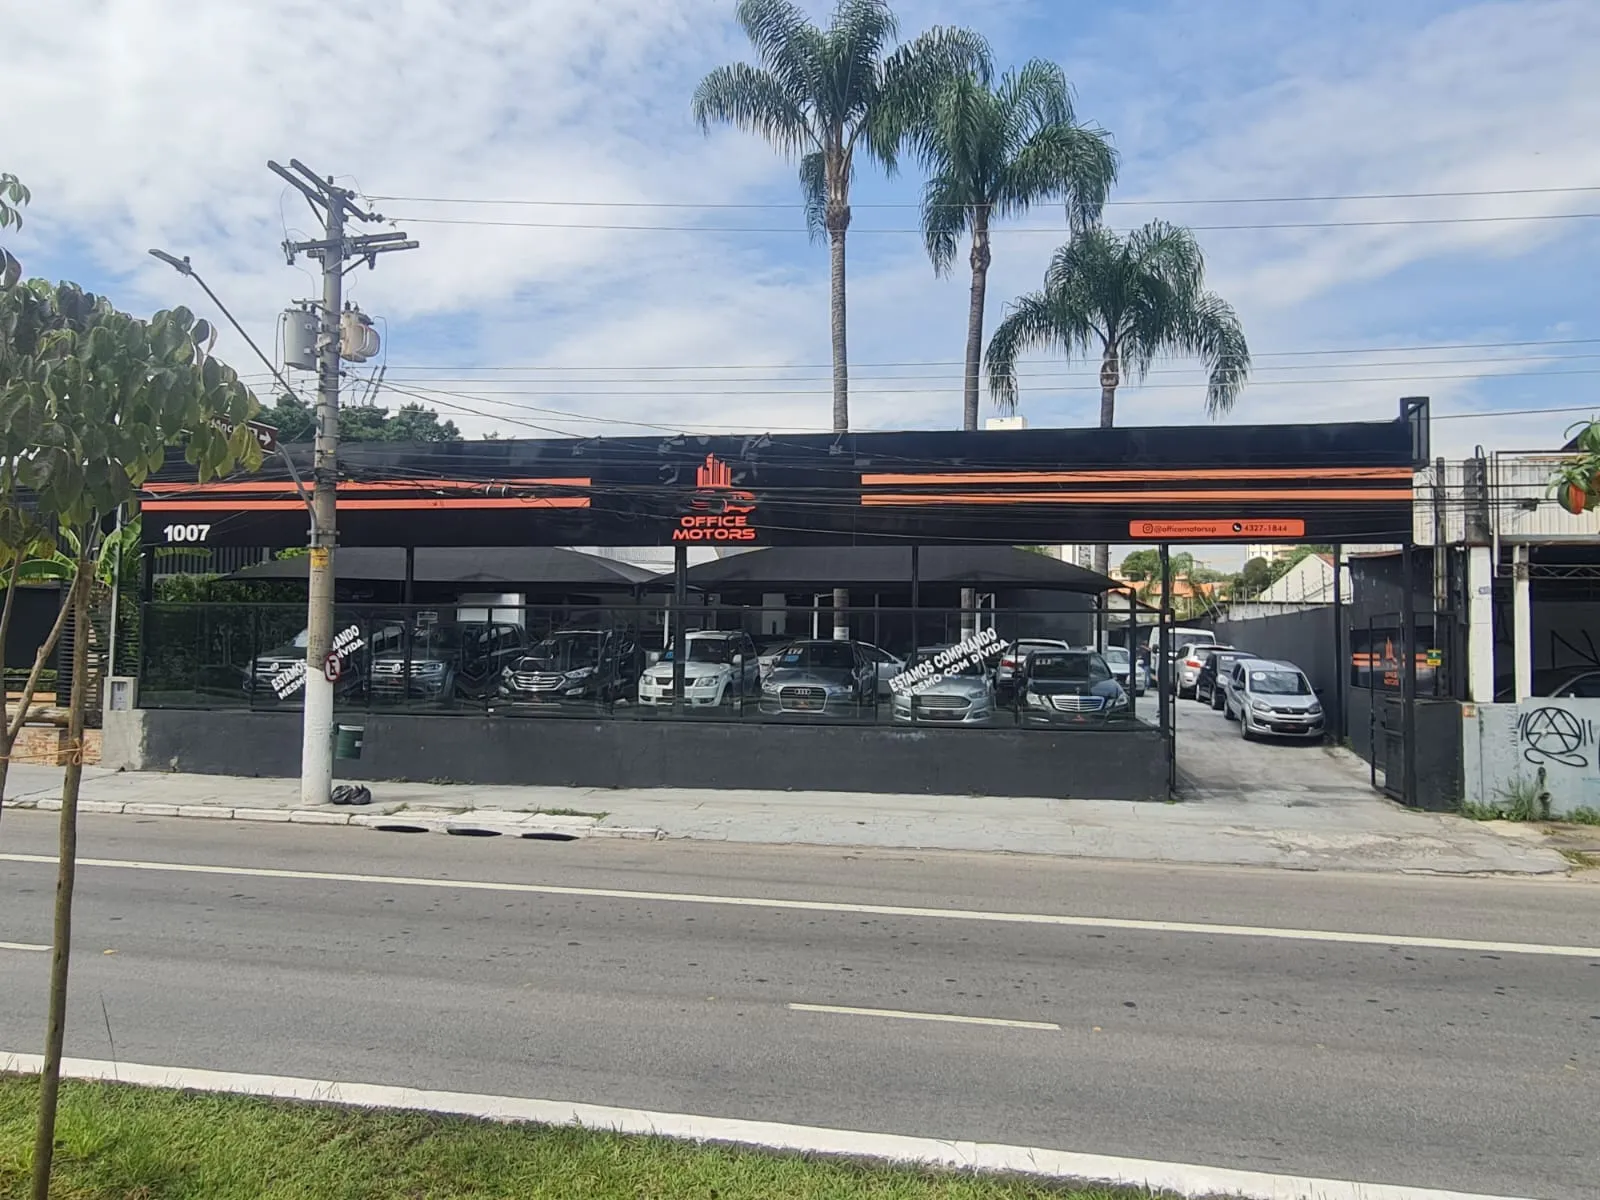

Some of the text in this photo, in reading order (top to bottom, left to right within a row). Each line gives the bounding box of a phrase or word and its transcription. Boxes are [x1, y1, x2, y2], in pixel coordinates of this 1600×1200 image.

[681, 516, 747, 527] OFFICE
[1244, 524, 1288, 532] 4327-1844
[163, 524, 211, 542] 1007
[672, 528, 756, 540] MOTORS
[888, 627, 998, 692] ESTAMOS COMPRANDO
[902, 674, 942, 697] MESMO
[943, 659, 970, 677] COM
